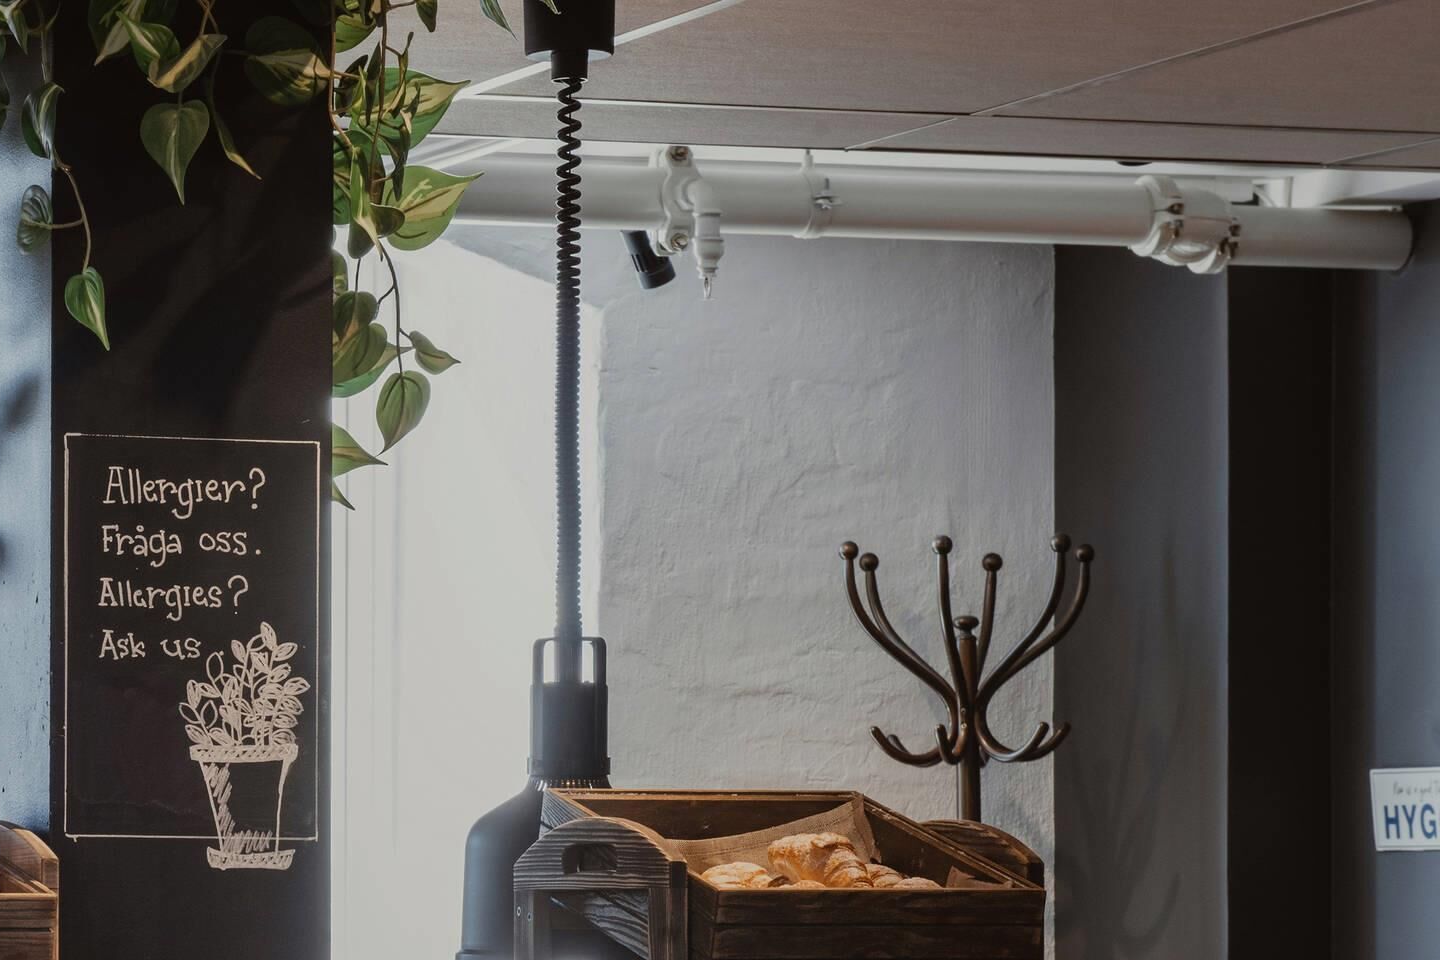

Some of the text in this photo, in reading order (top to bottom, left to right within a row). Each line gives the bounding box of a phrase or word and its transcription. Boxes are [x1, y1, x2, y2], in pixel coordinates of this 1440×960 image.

[102, 465, 266, 520] Allergier?
[101, 525, 183, 568] Fråga
[97, 574, 249, 622] Allergies?
[98, 628, 202, 660] Ask us
